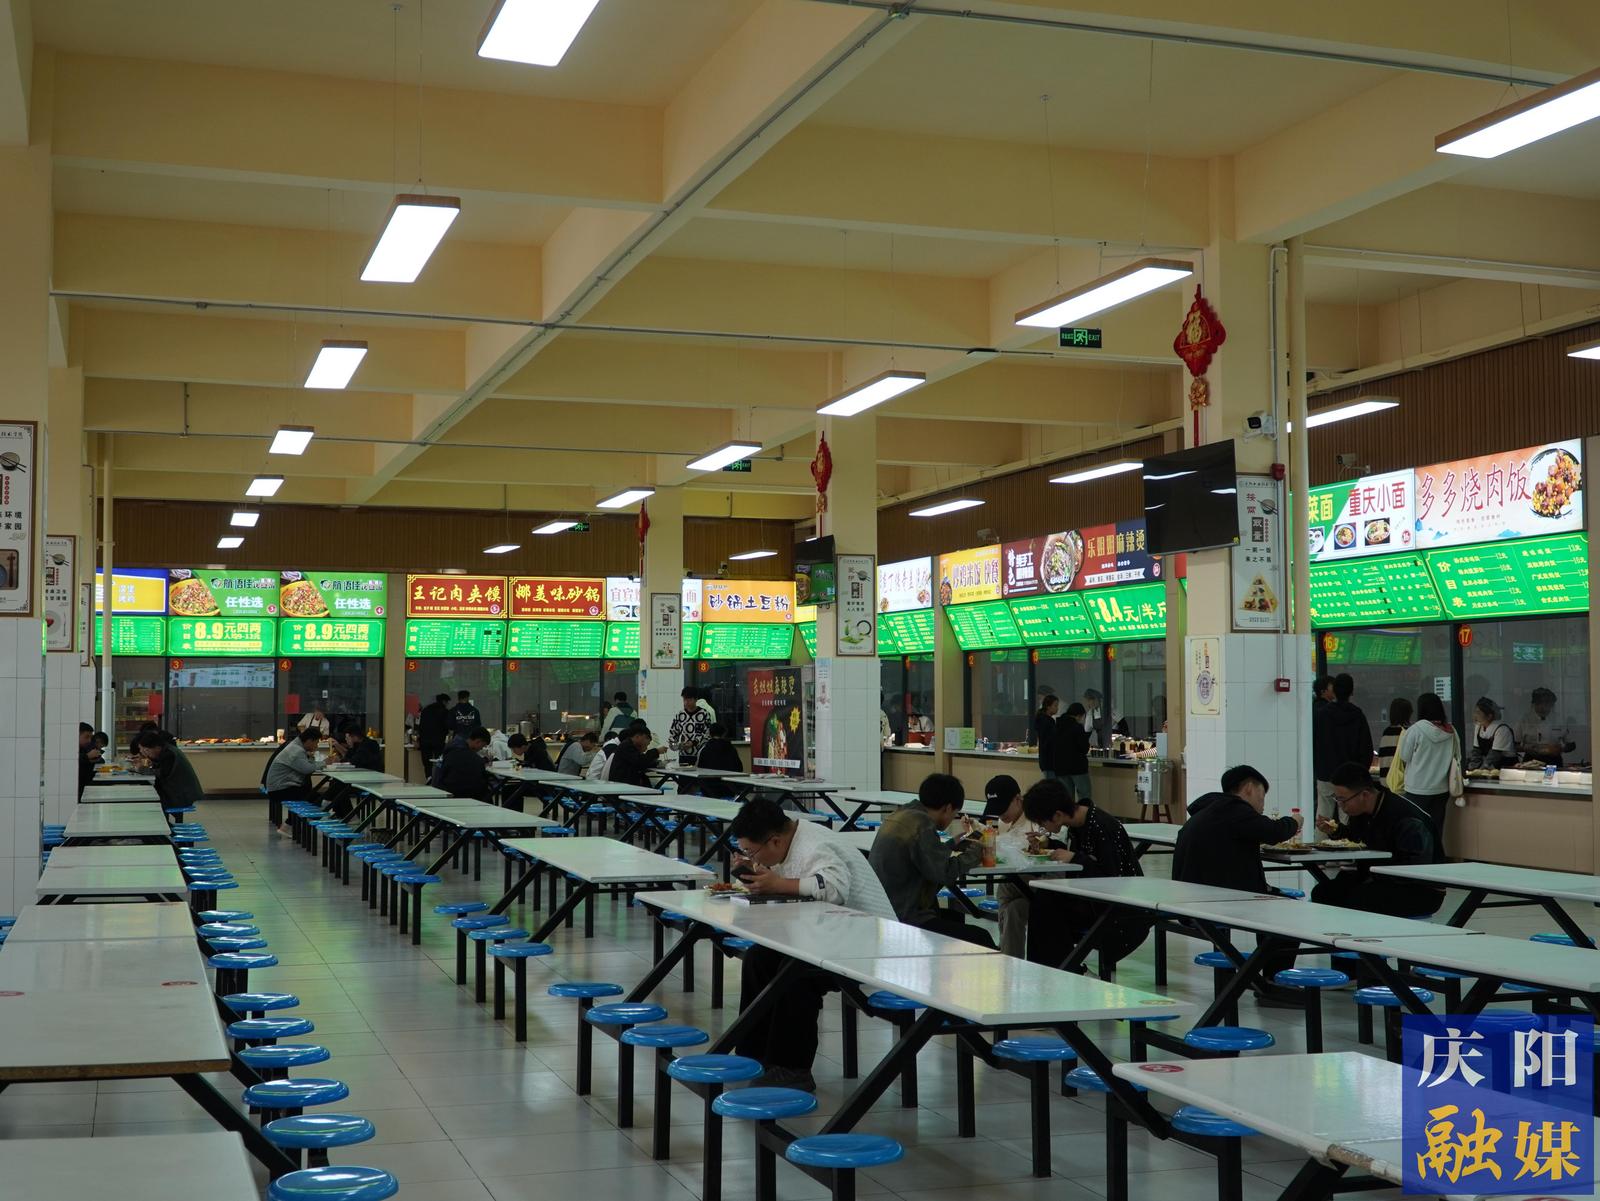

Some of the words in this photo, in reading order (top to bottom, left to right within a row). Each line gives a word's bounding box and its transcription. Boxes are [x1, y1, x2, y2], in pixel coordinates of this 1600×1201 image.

[1420, 460, 1532, 521] 多多烧肉饭
[1349, 482, 1406, 517] 重庆小面
[0, 522, 22, 531] 家园
[413, 584, 502, 603] 王记肉夹馍
[225, 596, 264, 609] 任性选
[334, 597, 372, 610] 任性选
[709, 594, 790, 611] 砂锅土豆粉
[1460, 628, 1469, 643] 17
[173, 660, 179, 669] 3
[281, 661, 288, 669] 4
[409, 662, 415, 670] 5
[509, 662, 515, 670] 6
[606, 663, 612, 671] 7
[700, 663, 706, 671] 8
